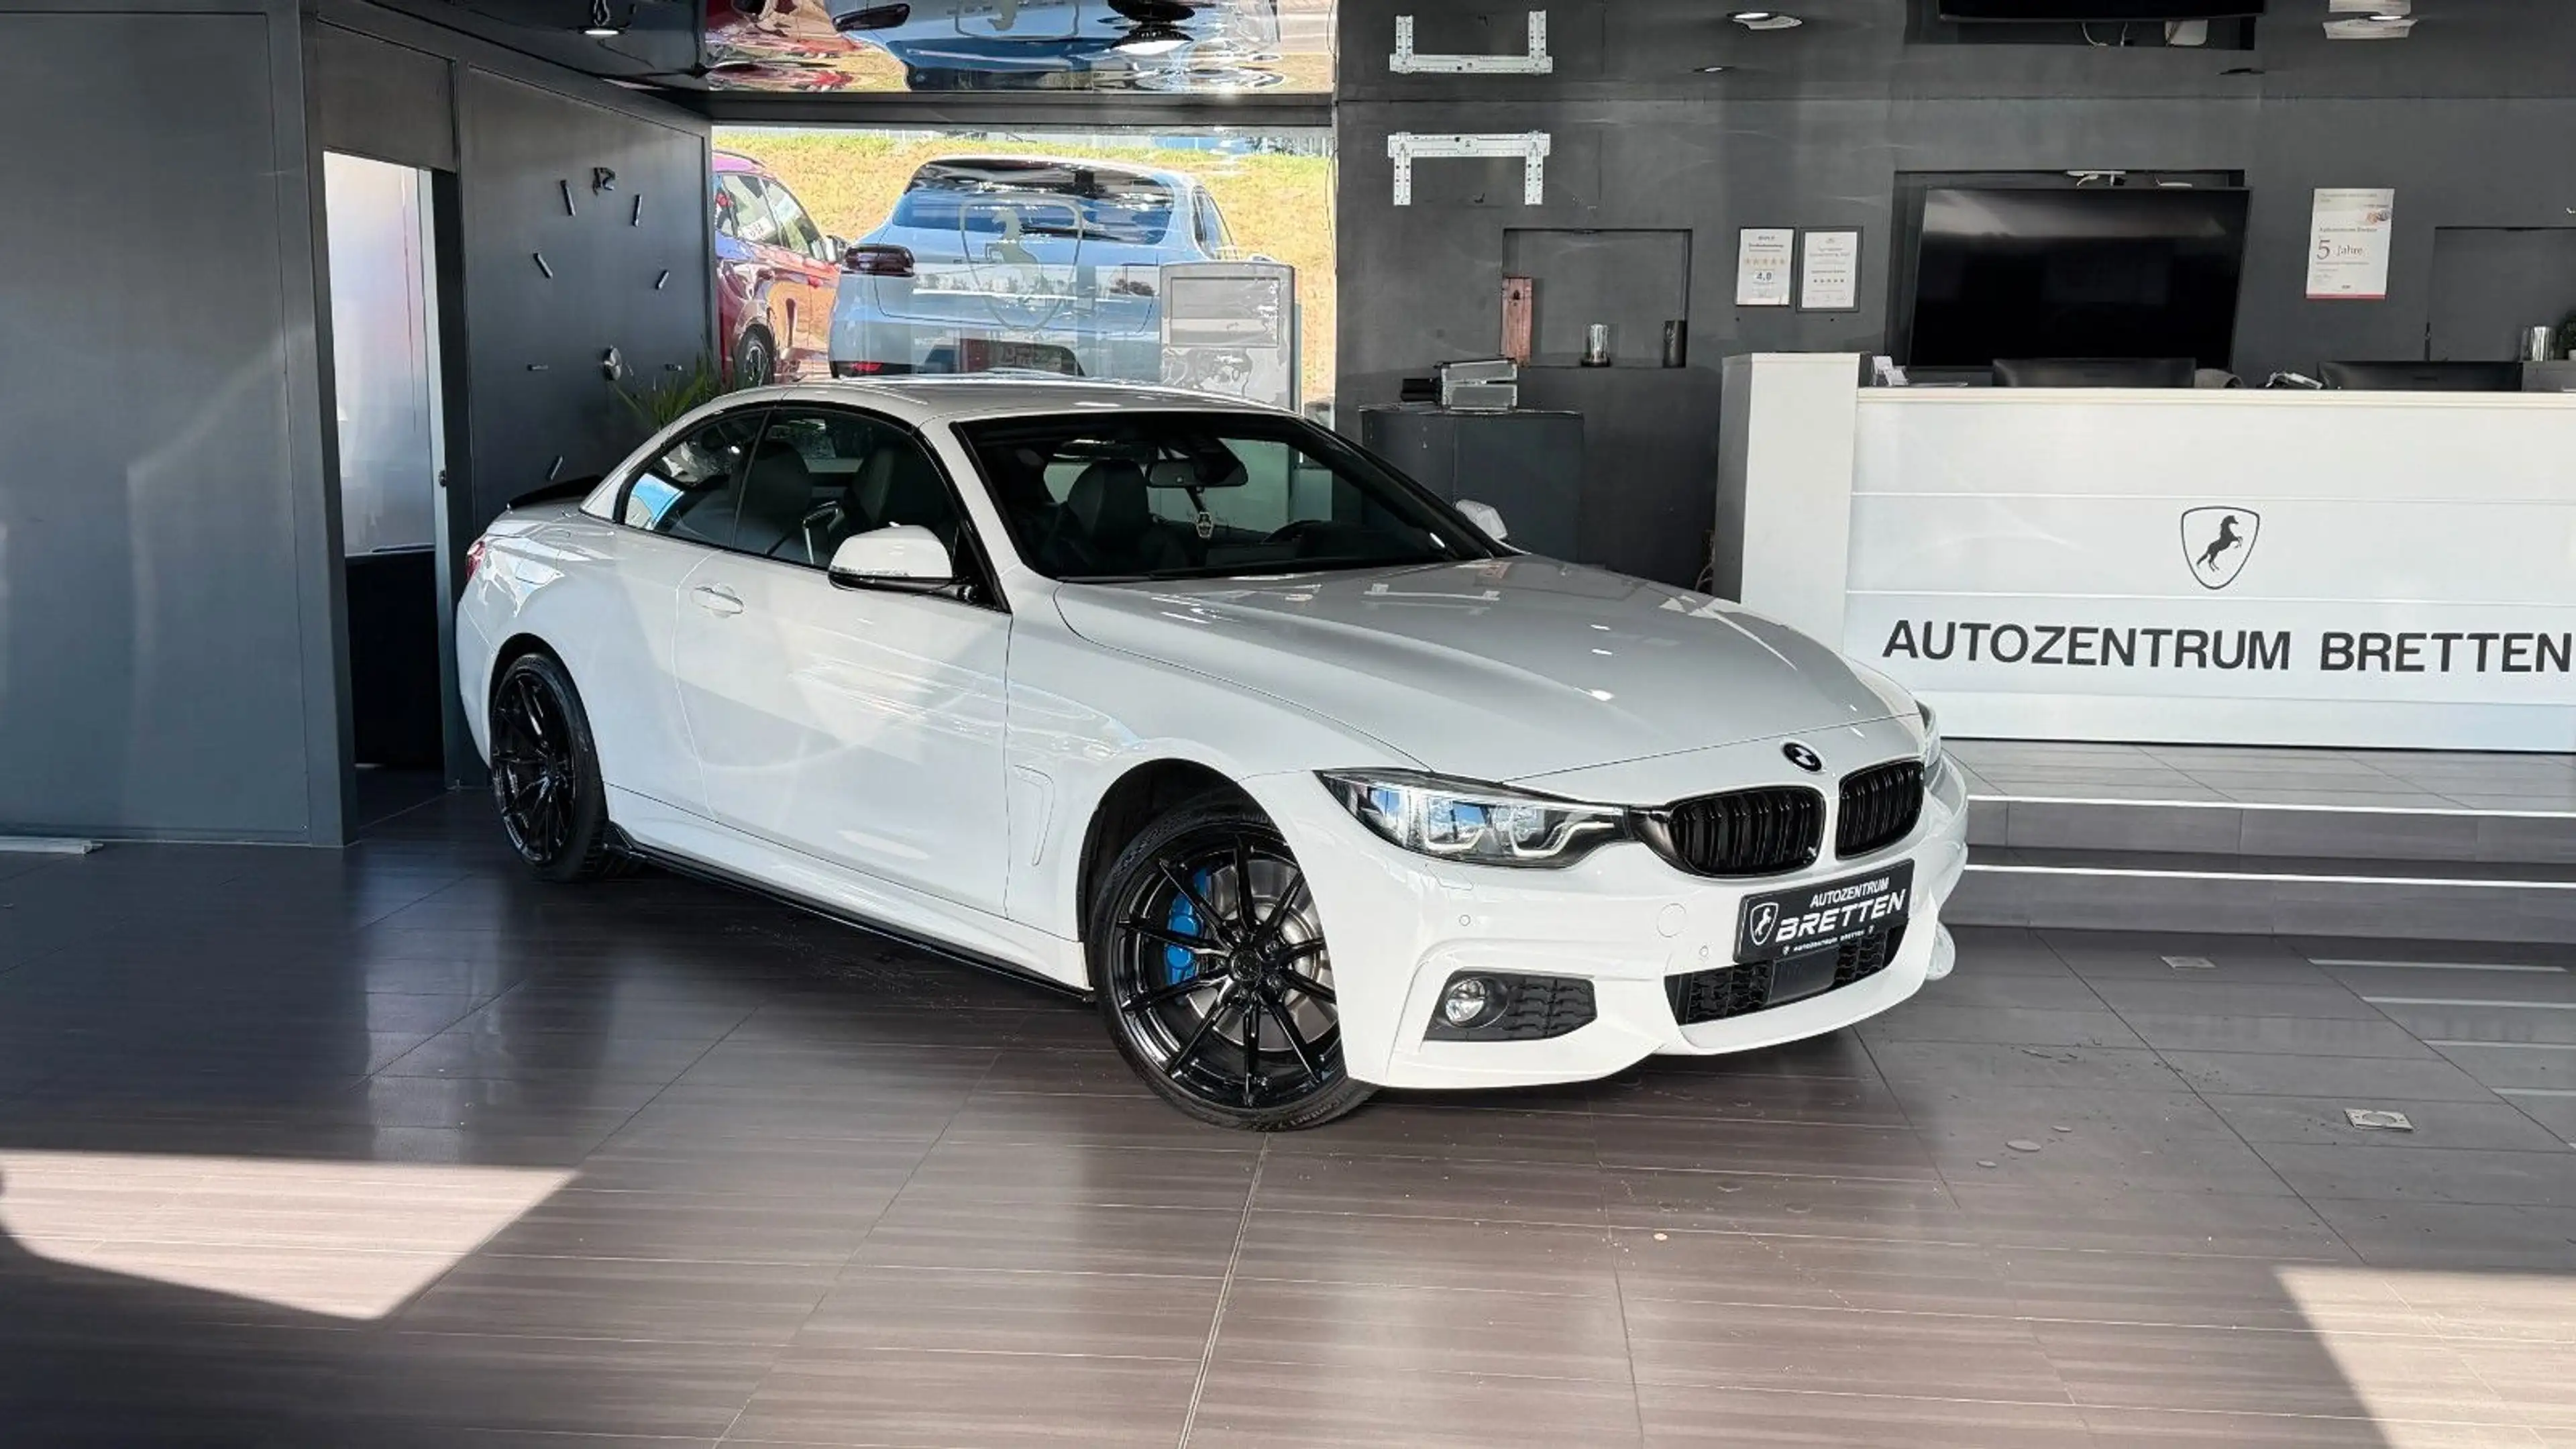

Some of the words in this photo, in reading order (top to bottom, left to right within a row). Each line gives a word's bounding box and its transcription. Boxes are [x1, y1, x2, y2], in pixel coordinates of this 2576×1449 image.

[2316, 239, 2331, 260] 5
[2337, 244, 2363, 257] Jahre
[1882, 620, 2291, 670] AUTOZENTRUM
[2320, 632, 2572, 672] BRETTEN
[1810, 877, 1890, 909] AUTOZENTRUM
[1775, 888, 1907, 943] BRETTEN
